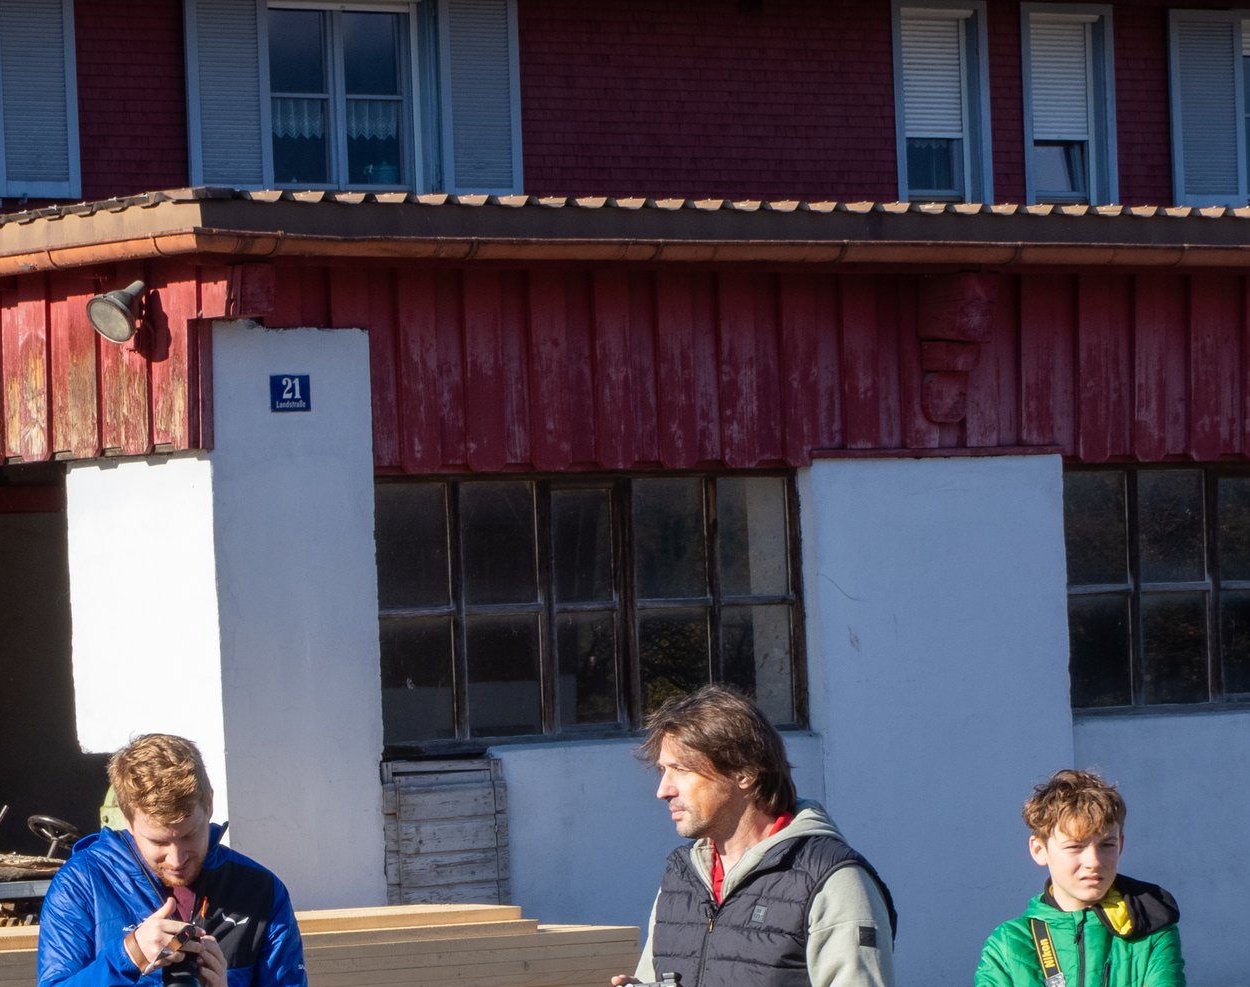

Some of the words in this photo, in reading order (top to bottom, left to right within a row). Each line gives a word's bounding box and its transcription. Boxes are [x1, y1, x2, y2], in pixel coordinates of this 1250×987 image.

[281, 377, 302, 399] 21
[276, 400, 306, 409] Landstraße
[1040, 938, 1055, 968] Nikon
